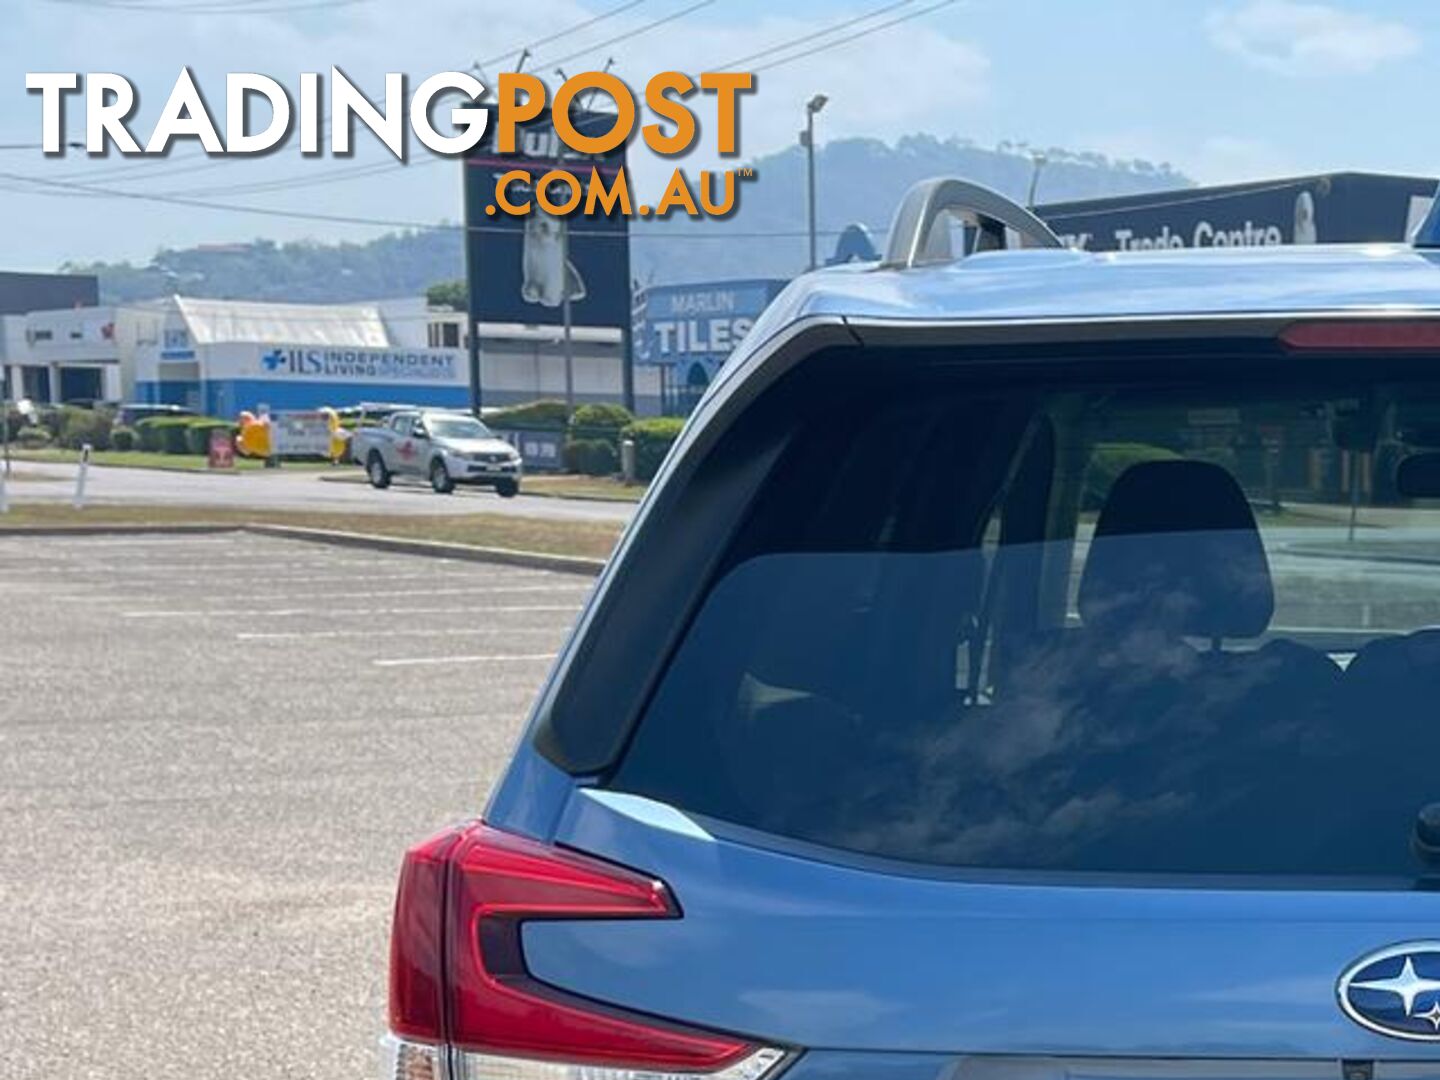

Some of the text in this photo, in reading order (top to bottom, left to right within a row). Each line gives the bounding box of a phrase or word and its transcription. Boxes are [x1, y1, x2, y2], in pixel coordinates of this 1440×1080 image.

[672, 291, 735, 312] MARLIN
[653, 318, 754, 353] TILES
[289, 350, 321, 374] ILS
[324, 351, 455, 367] INDEPENDENT
[324, 363, 376, 377] LIVING
